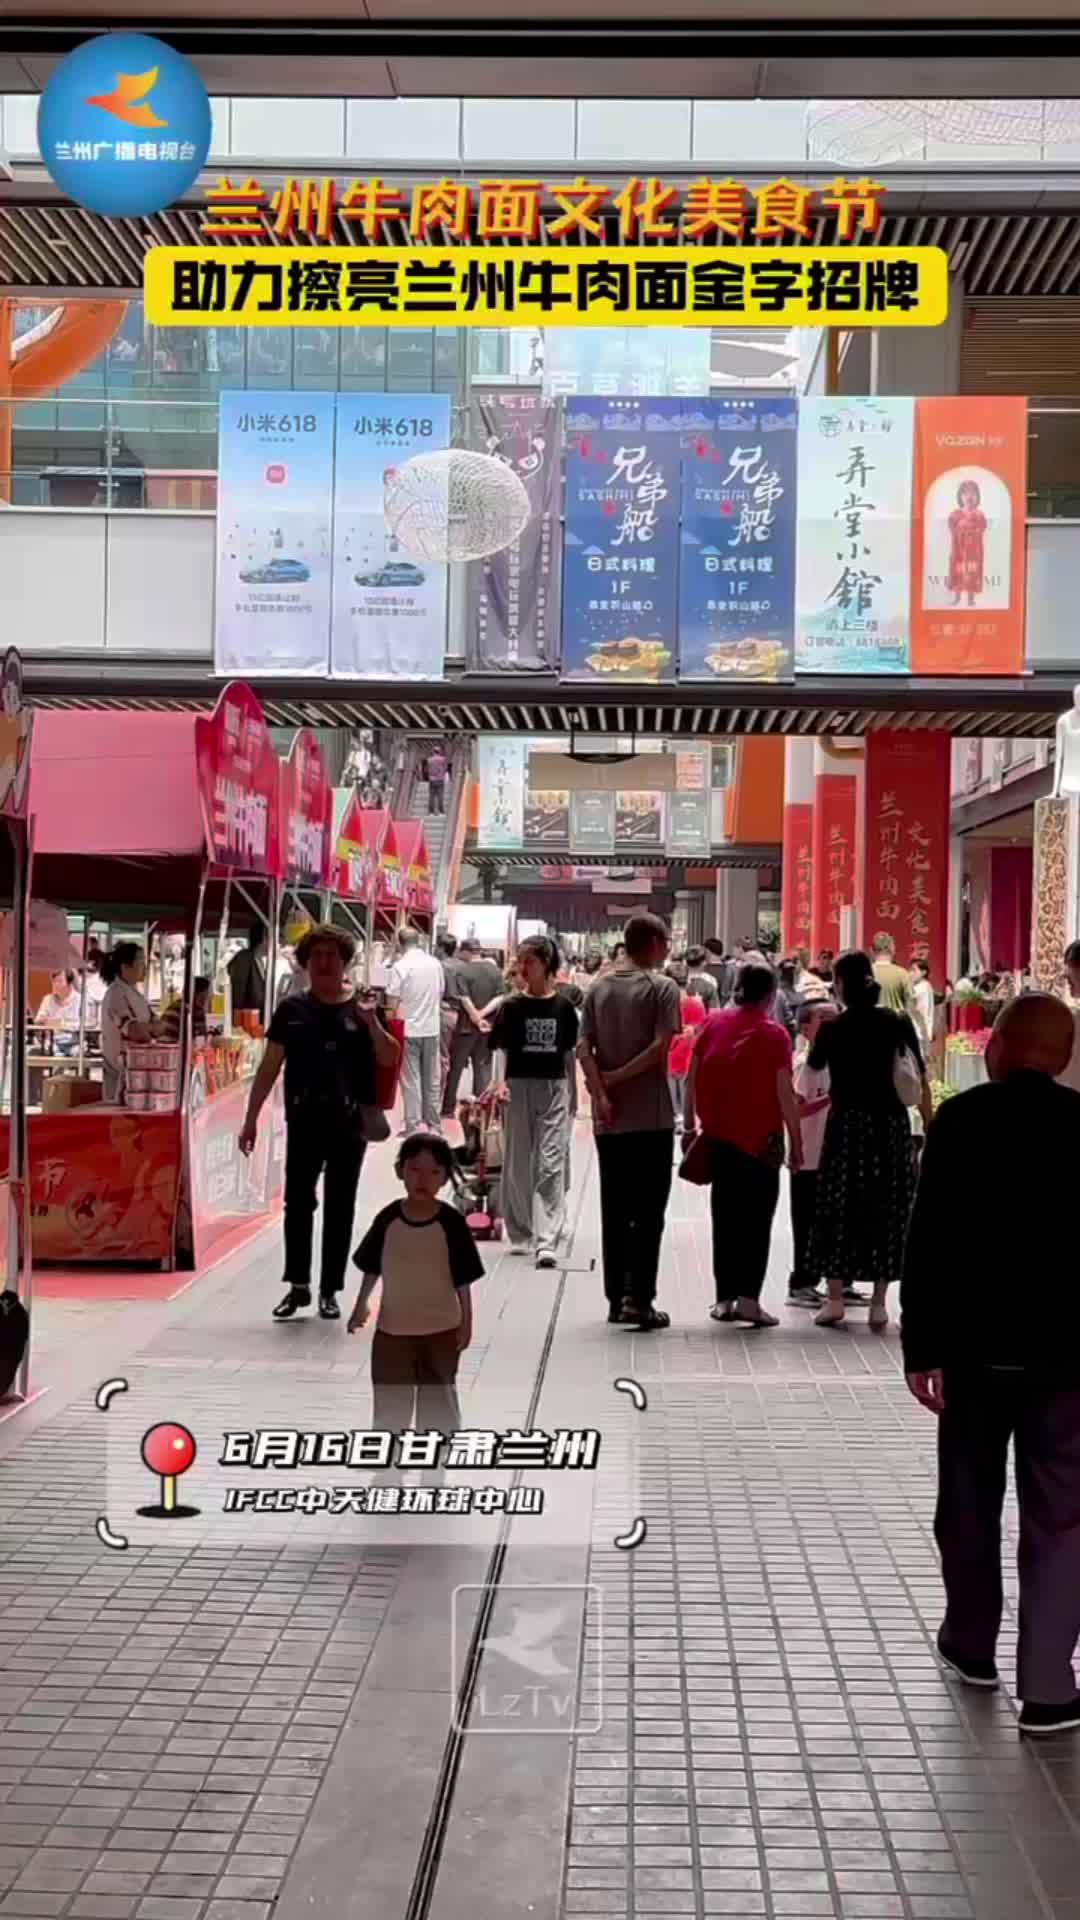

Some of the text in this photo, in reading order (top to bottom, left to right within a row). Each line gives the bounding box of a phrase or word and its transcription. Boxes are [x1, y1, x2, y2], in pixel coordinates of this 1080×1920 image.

[236, 413, 317, 433] 小米618
[353, 416, 433, 437] 小米618
[586, 556, 656, 573] 日式料理
[703, 556, 774, 573] 日式料理
[610, 580, 631, 594] 1F
[728, 580, 750, 595] 1F
